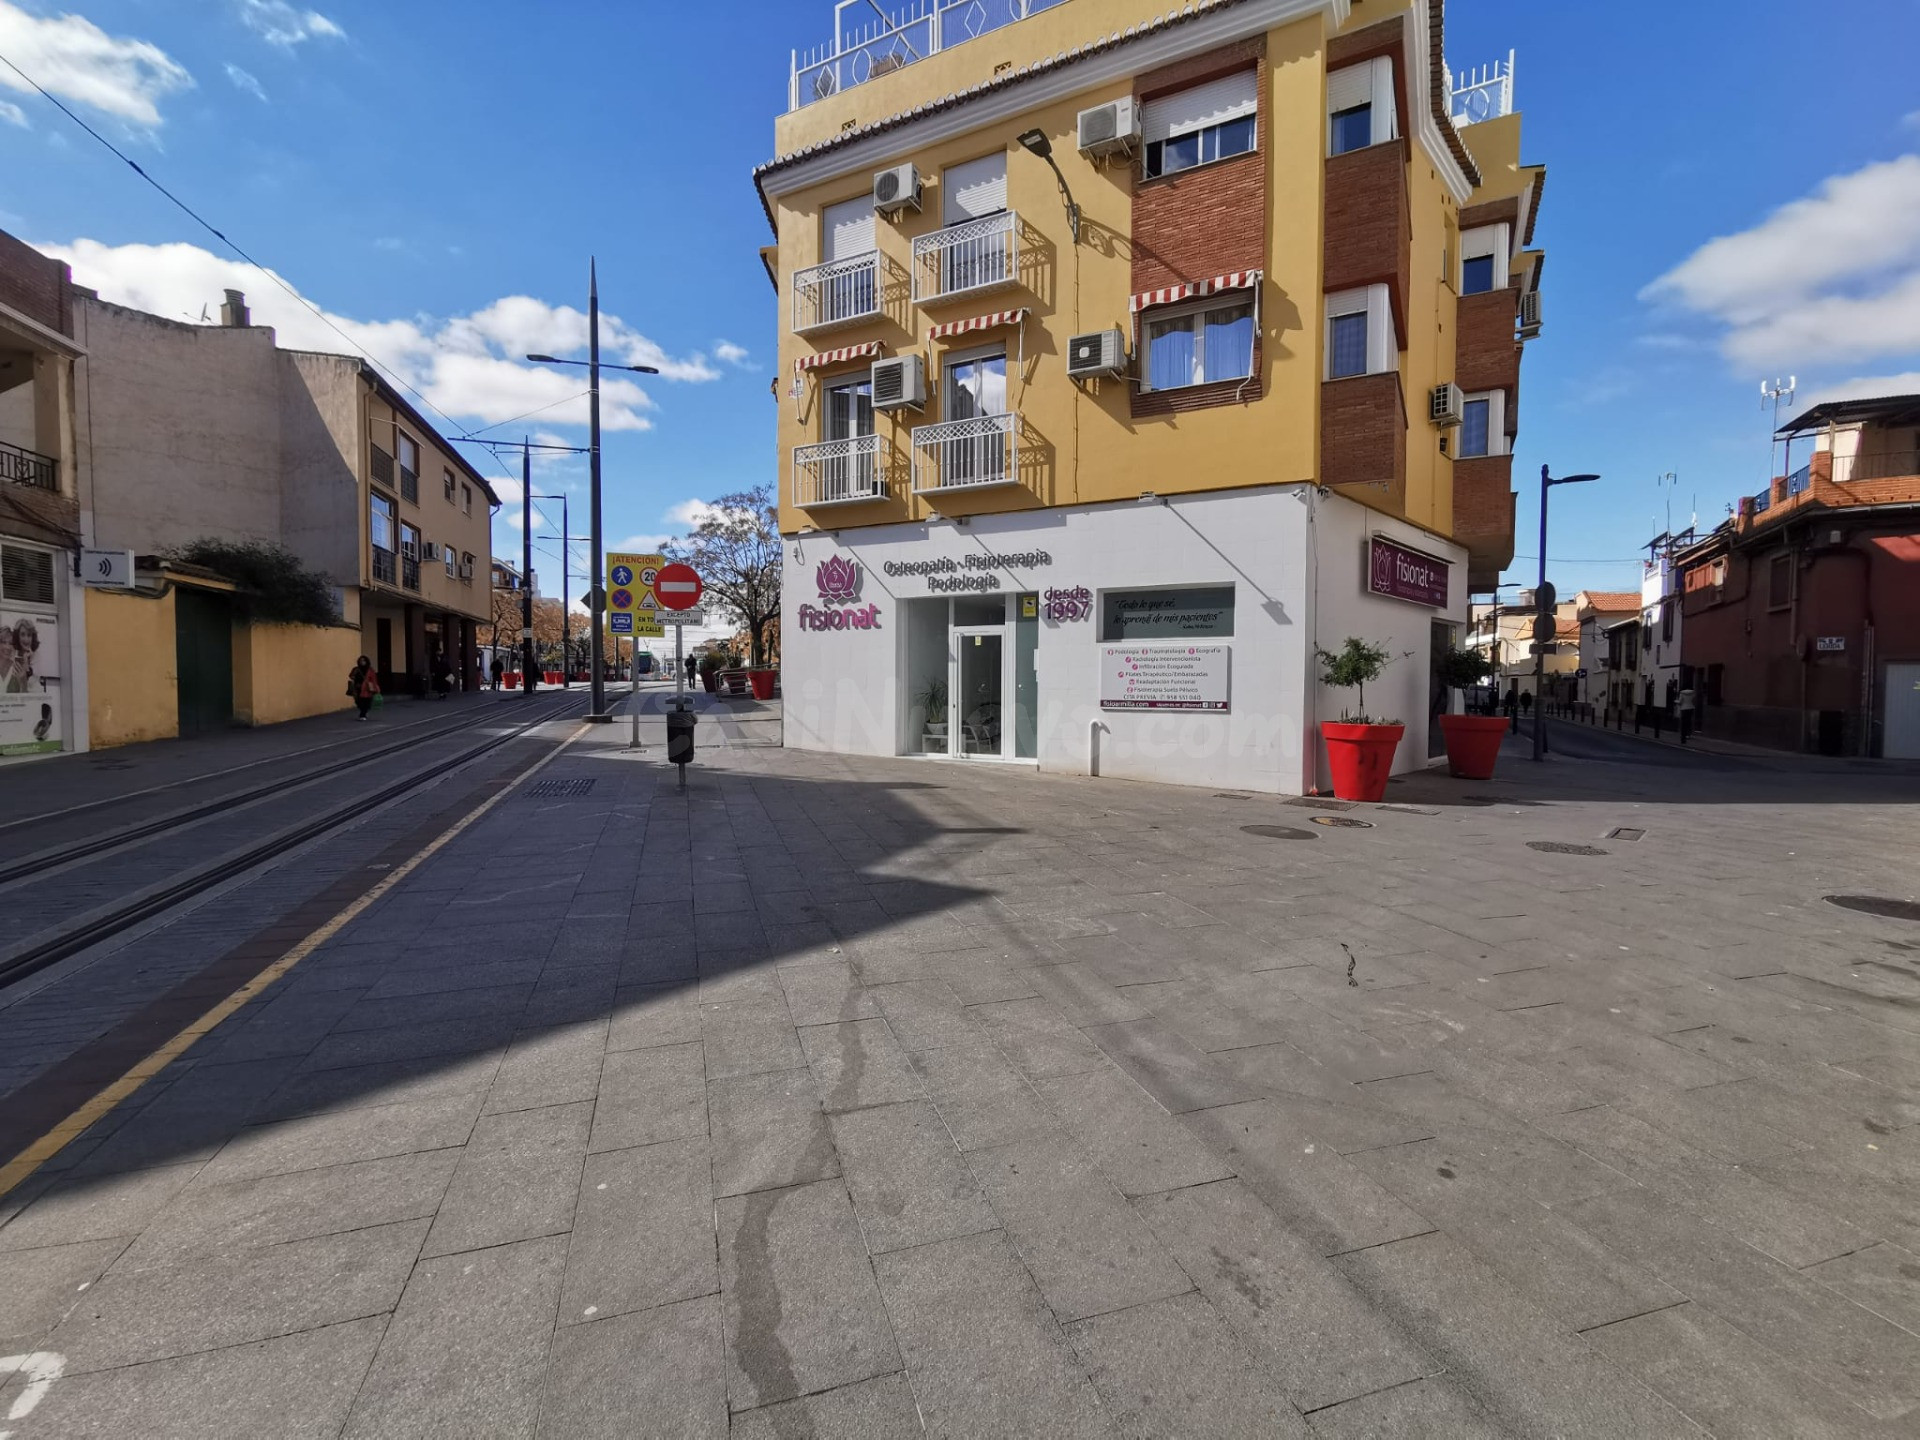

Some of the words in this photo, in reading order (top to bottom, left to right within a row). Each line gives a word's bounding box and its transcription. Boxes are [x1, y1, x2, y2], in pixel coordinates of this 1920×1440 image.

[884, 556, 955, 576] Osteopatía
[965, 549, 1050, 570] Fisioterapia
[1396, 552, 1429, 588] fisionat
[644, 572, 656, 582] 20
[928, 572, 998, 590] Podología
[1044, 584, 1090, 602] desde
[797, 603, 881, 630] fisionat
[1044, 601, 1090, 619] 1997
[645, 625, 661, 633] CALLE
